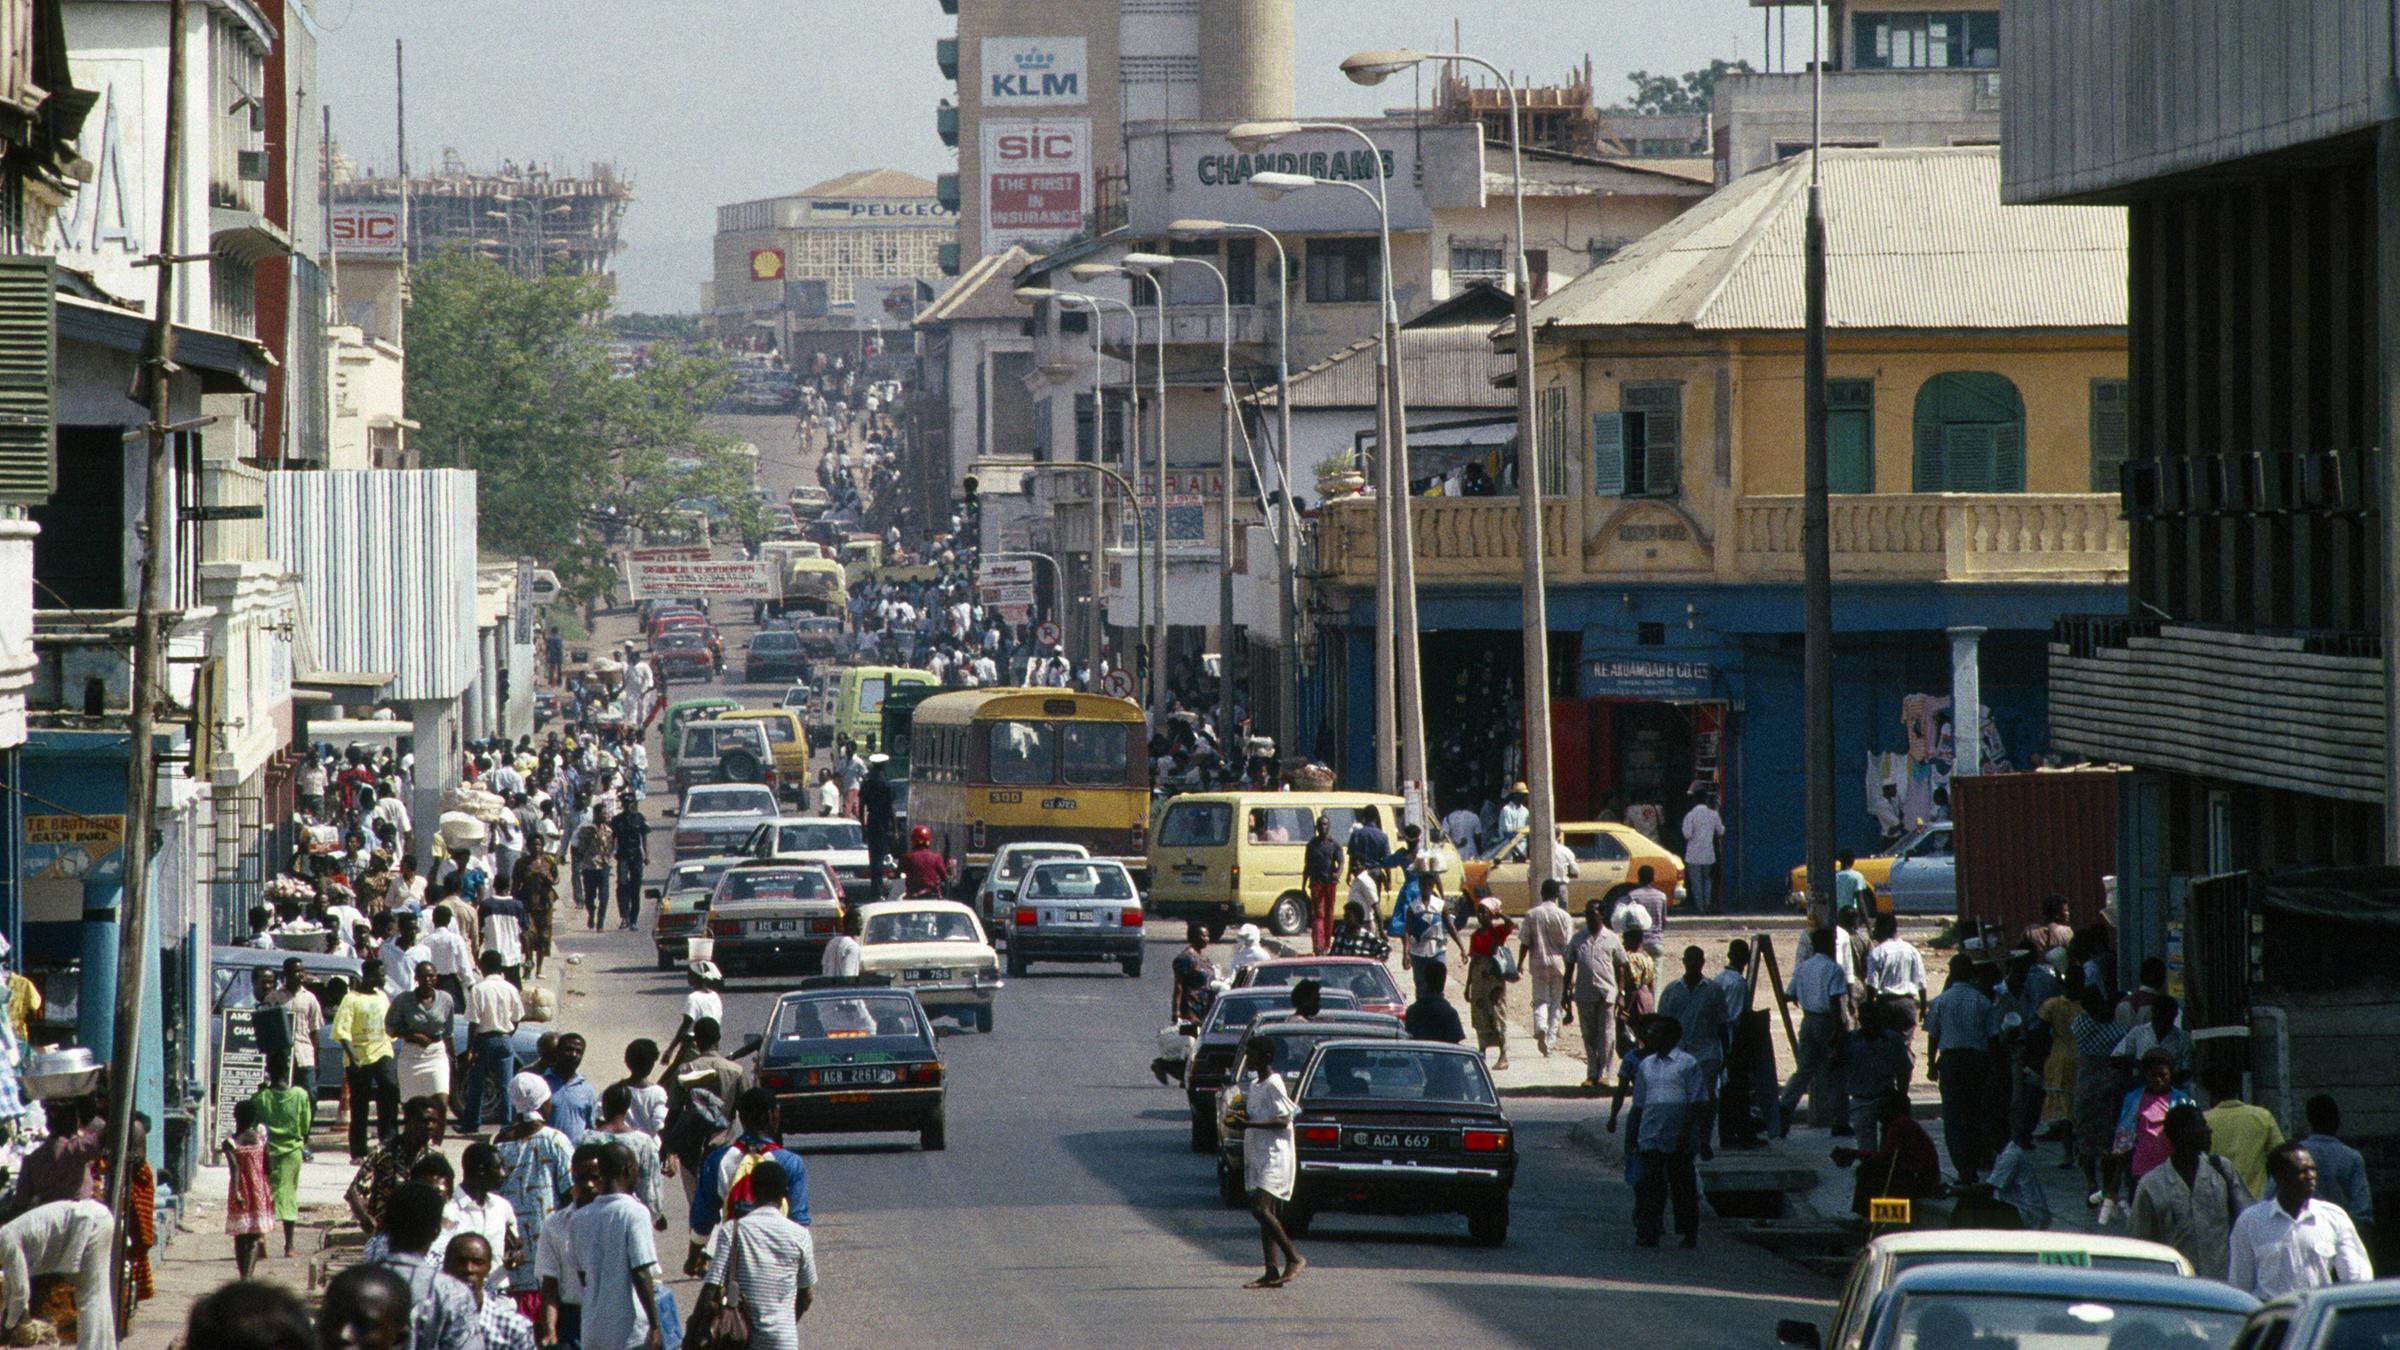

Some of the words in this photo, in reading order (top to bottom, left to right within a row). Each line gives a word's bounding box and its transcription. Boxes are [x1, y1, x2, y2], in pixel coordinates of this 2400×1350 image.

[992, 73, 1078, 96] KLM
[998, 177, 1027, 190] THE
[1030, 176, 1073, 190] FIRST
[1028, 194, 1043, 208] IN
[992, 210, 1080, 224] INSURANCE
[1373, 1135, 1400, 1148] ACA
[1404, 1135, 1430, 1148] 669
[1874, 1204, 1906, 1220] TAXI
